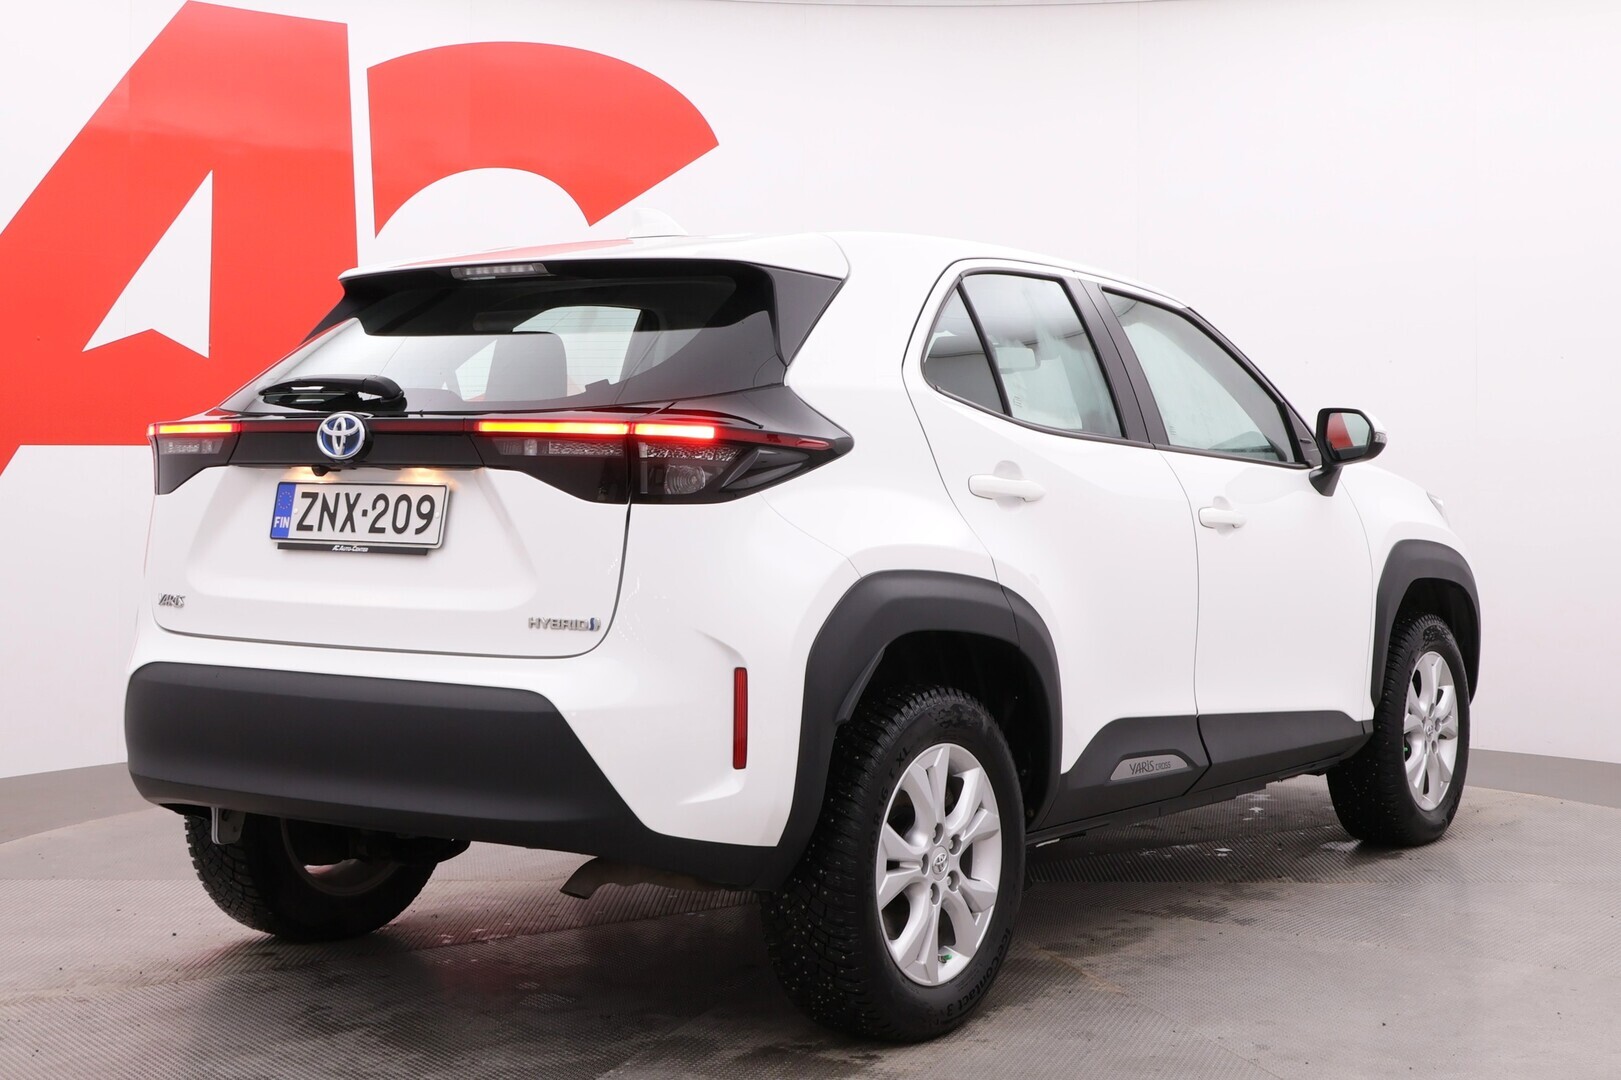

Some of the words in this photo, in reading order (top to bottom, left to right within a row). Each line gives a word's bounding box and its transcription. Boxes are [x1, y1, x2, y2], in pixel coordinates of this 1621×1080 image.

[273, 516, 290, 529] FIN
[528, 617, 589, 631] HYBRID
[1155, 761, 1171, 771] CROSS
